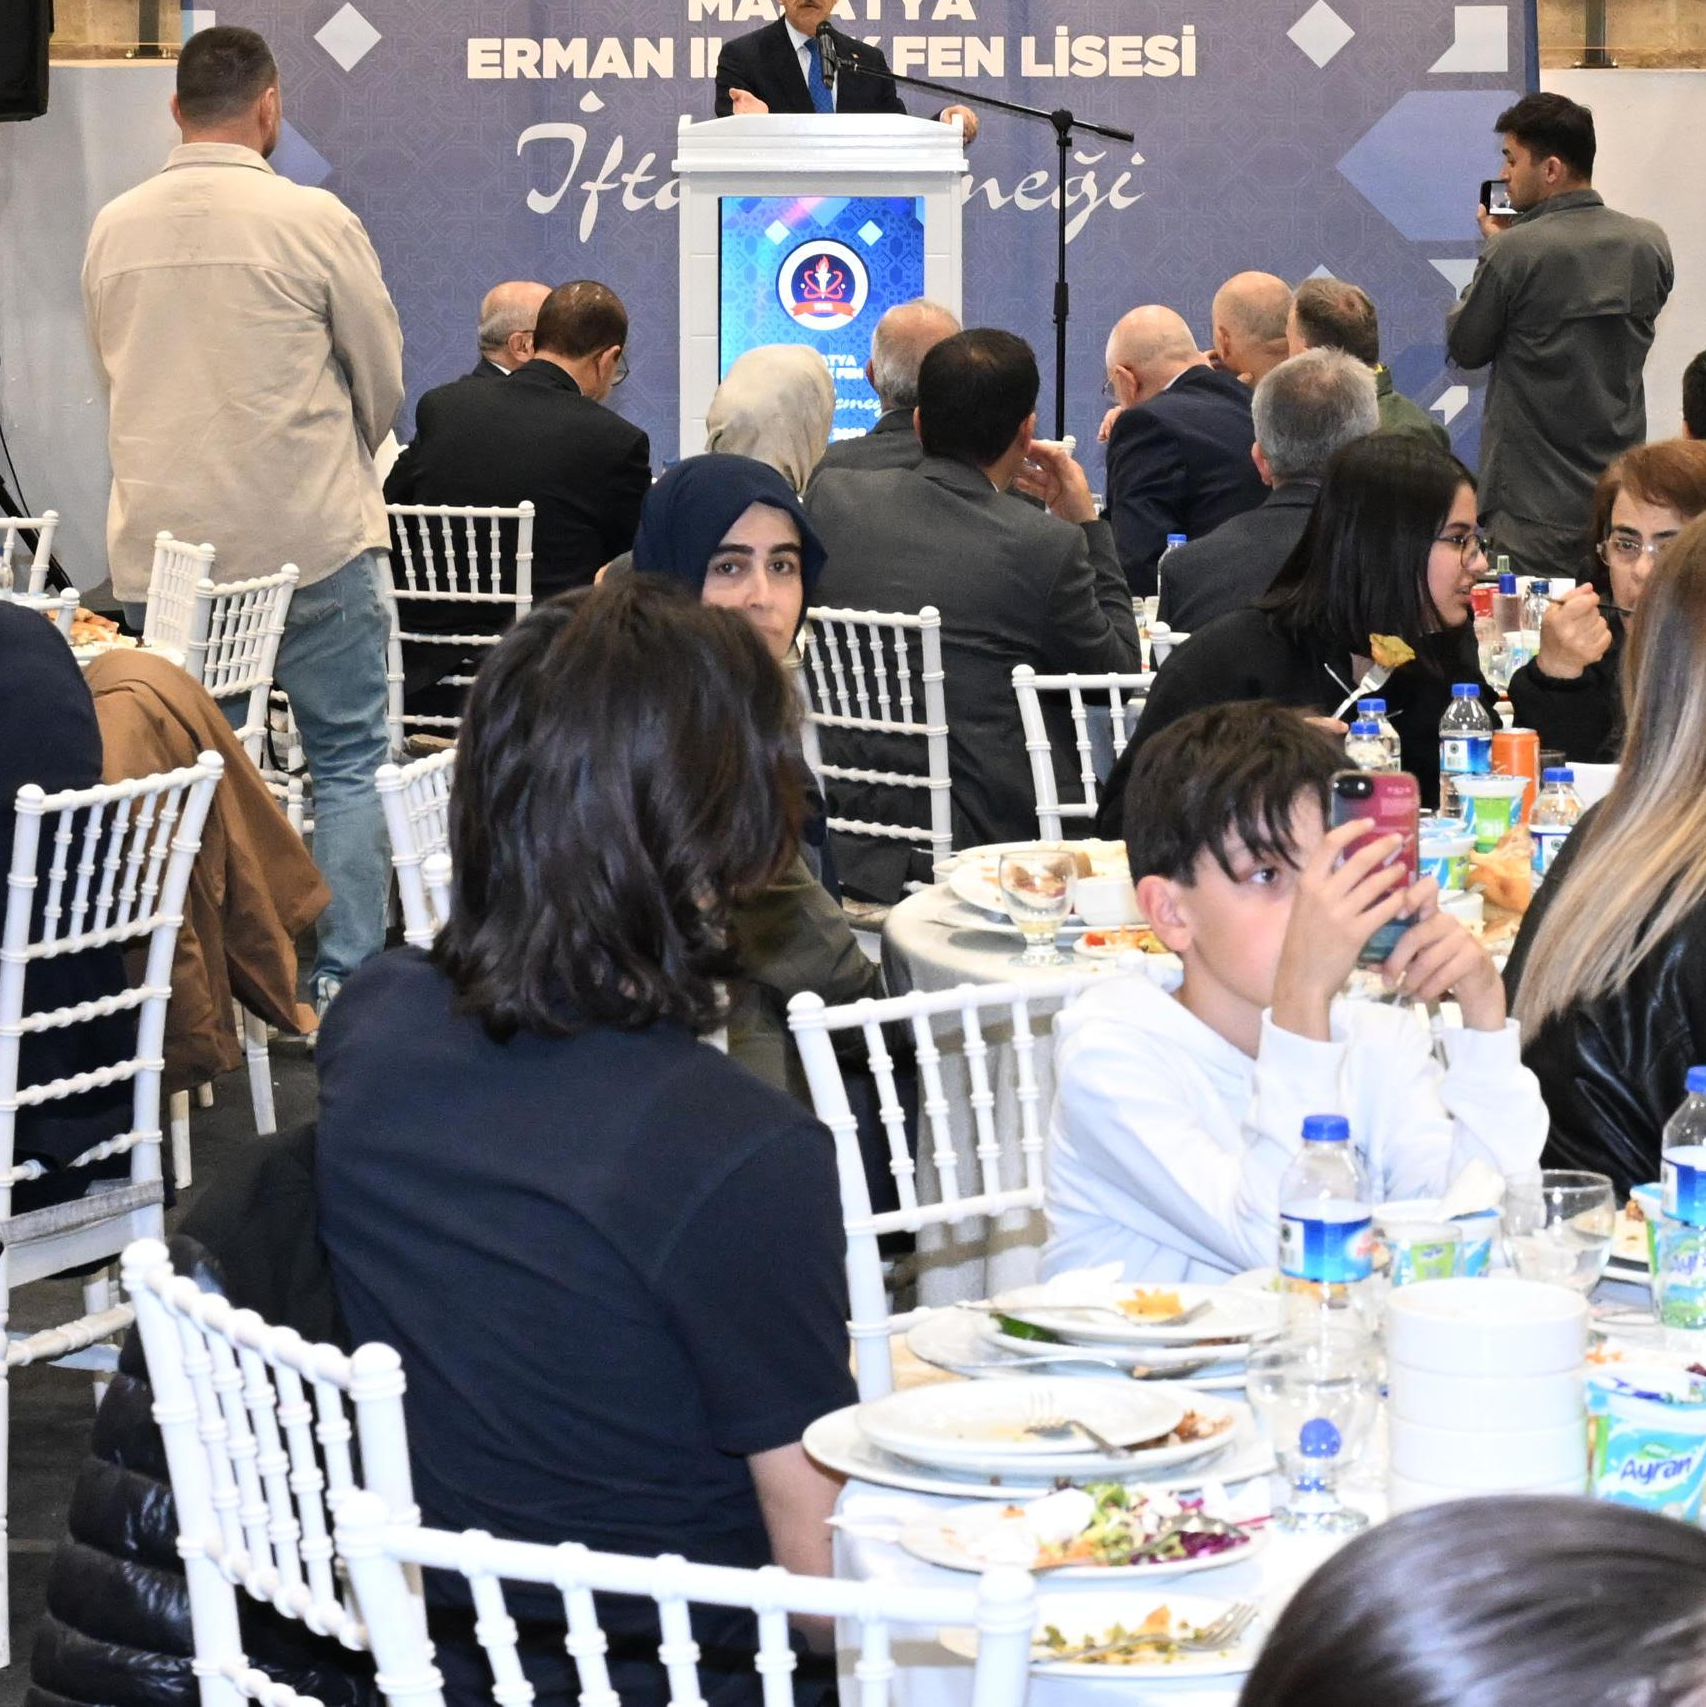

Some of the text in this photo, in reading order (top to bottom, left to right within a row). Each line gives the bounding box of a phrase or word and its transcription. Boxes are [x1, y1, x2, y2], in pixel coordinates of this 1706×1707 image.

[467, 37, 674, 79] ERMAN
[893, 36, 1004, 77] FEN
[1021, 25, 1196, 78] LİSESİ
[1620, 1456, 1692, 1485] Ayran
